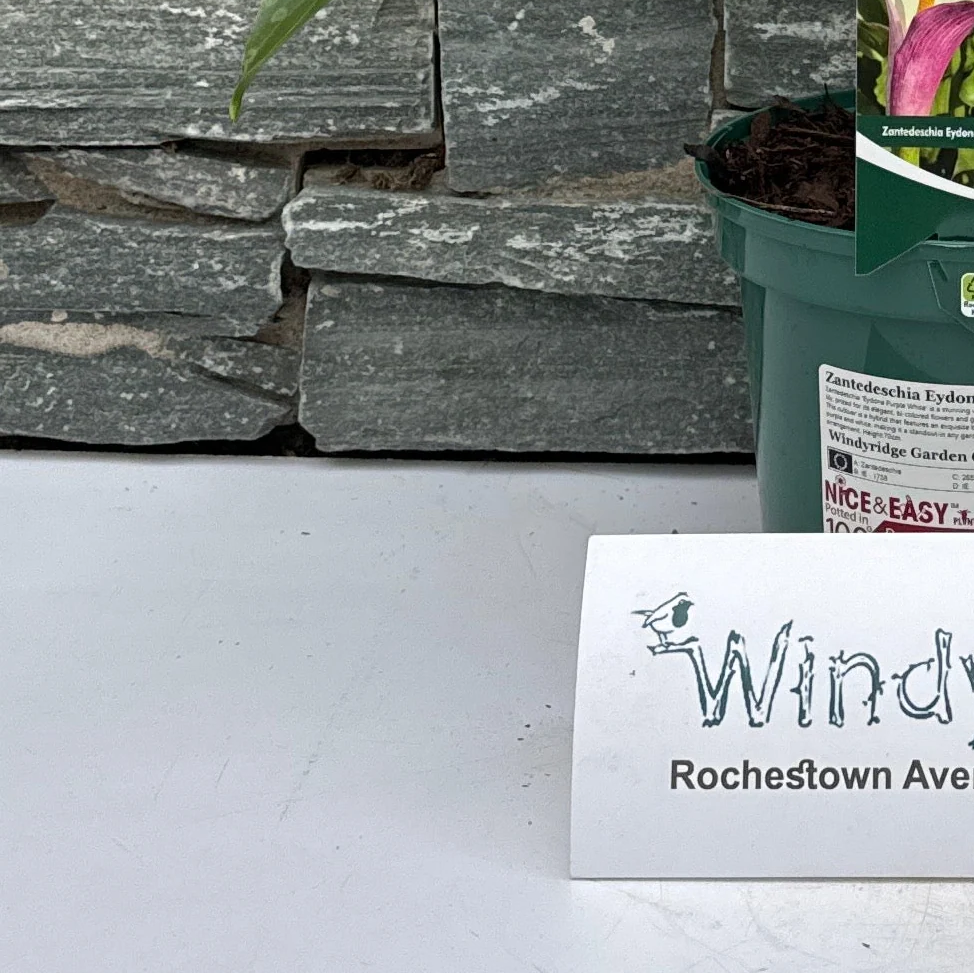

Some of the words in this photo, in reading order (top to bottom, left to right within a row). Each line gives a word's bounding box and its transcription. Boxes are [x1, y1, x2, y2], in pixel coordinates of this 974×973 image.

[882, 126, 944, 137] Zantedeschia
[825, 371, 920, 401] Zantedeschia
[829, 429, 906, 458] Windyridge
[911, 447, 967, 462] Garden
[825, 502, 857, 522] Potted
[860, 514, 869, 525] in
[671, 759, 892, 790] Rochestown
